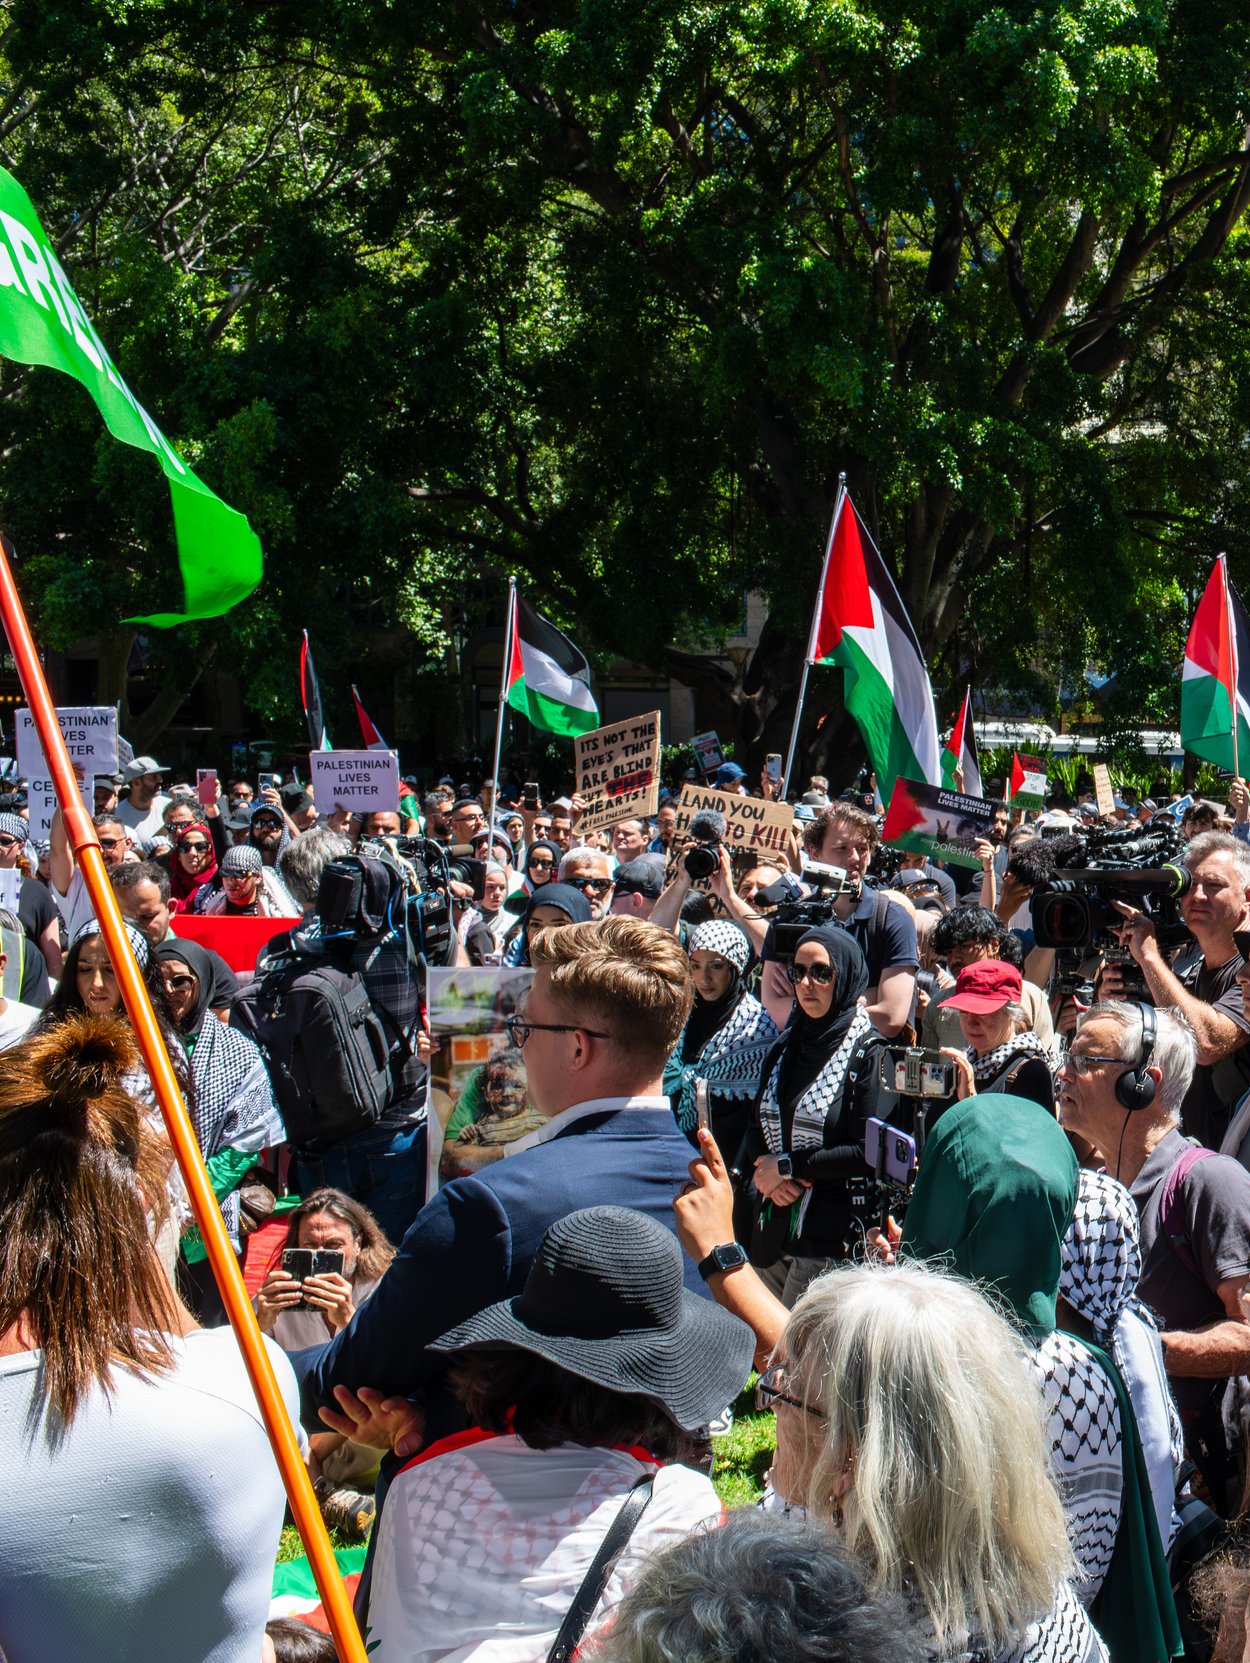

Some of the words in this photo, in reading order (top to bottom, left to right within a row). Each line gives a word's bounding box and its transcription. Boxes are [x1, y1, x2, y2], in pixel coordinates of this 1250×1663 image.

[24, 716, 109, 728] PSTINIAN
[603, 730, 627, 747] NOT
[631, 721, 656, 740] THE
[622, 739, 653, 757] THAT
[317, 760, 390, 770] PALESTINIAN
[582, 771, 609, 790] ARE
[613, 756, 653, 779] BLIND
[339, 773, 371, 782] LIVES
[609, 771, 650, 796] THE
[333, 786, 379, 796] MATTER
[939, 791, 993, 811] PALESTINIAN
[582, 788, 647, 818] HEARTS!
[682, 790, 726, 813] LAND
[729, 800, 766, 821] YOU
[937, 798, 960, 809] LIVES
[960, 803, 992, 817] MATTER
[749, 823, 788, 852] KILL
